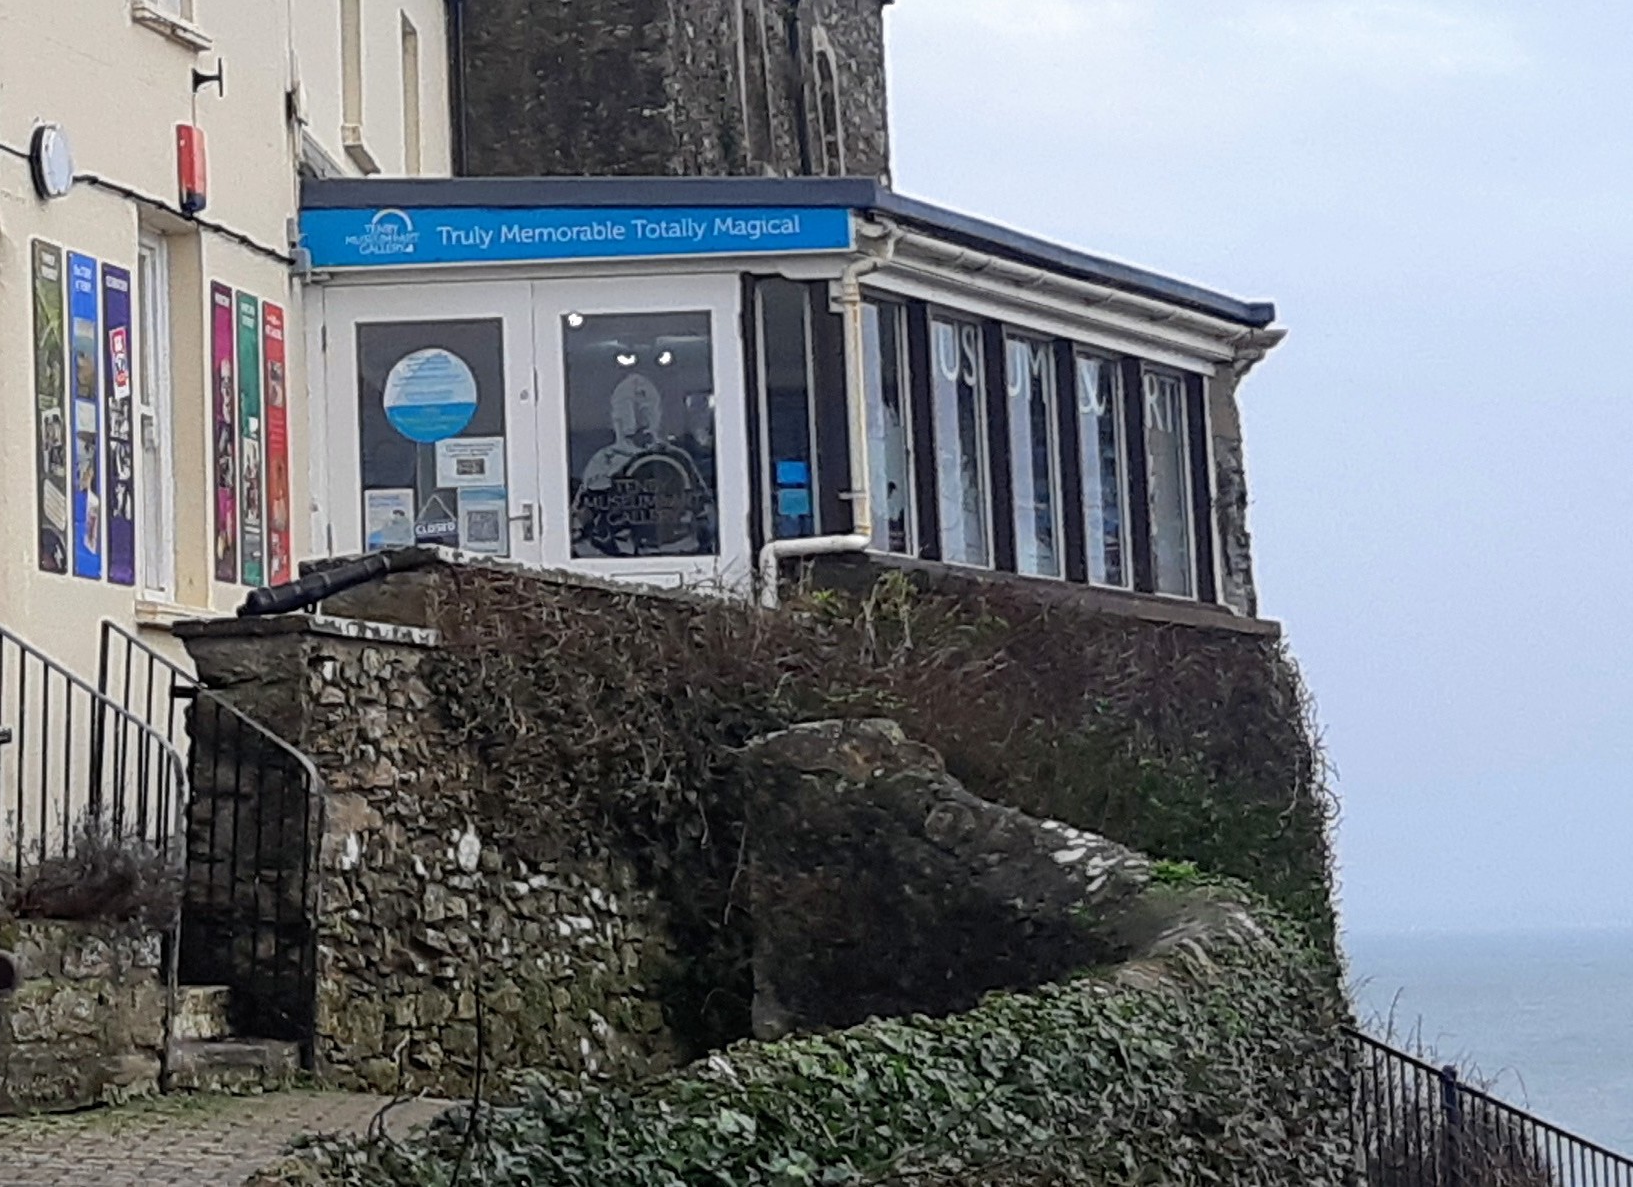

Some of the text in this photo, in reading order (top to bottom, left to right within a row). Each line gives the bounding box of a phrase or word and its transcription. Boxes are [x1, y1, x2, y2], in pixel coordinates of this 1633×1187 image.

[436, 214, 801, 249] Truly Memorable Totally Magical
